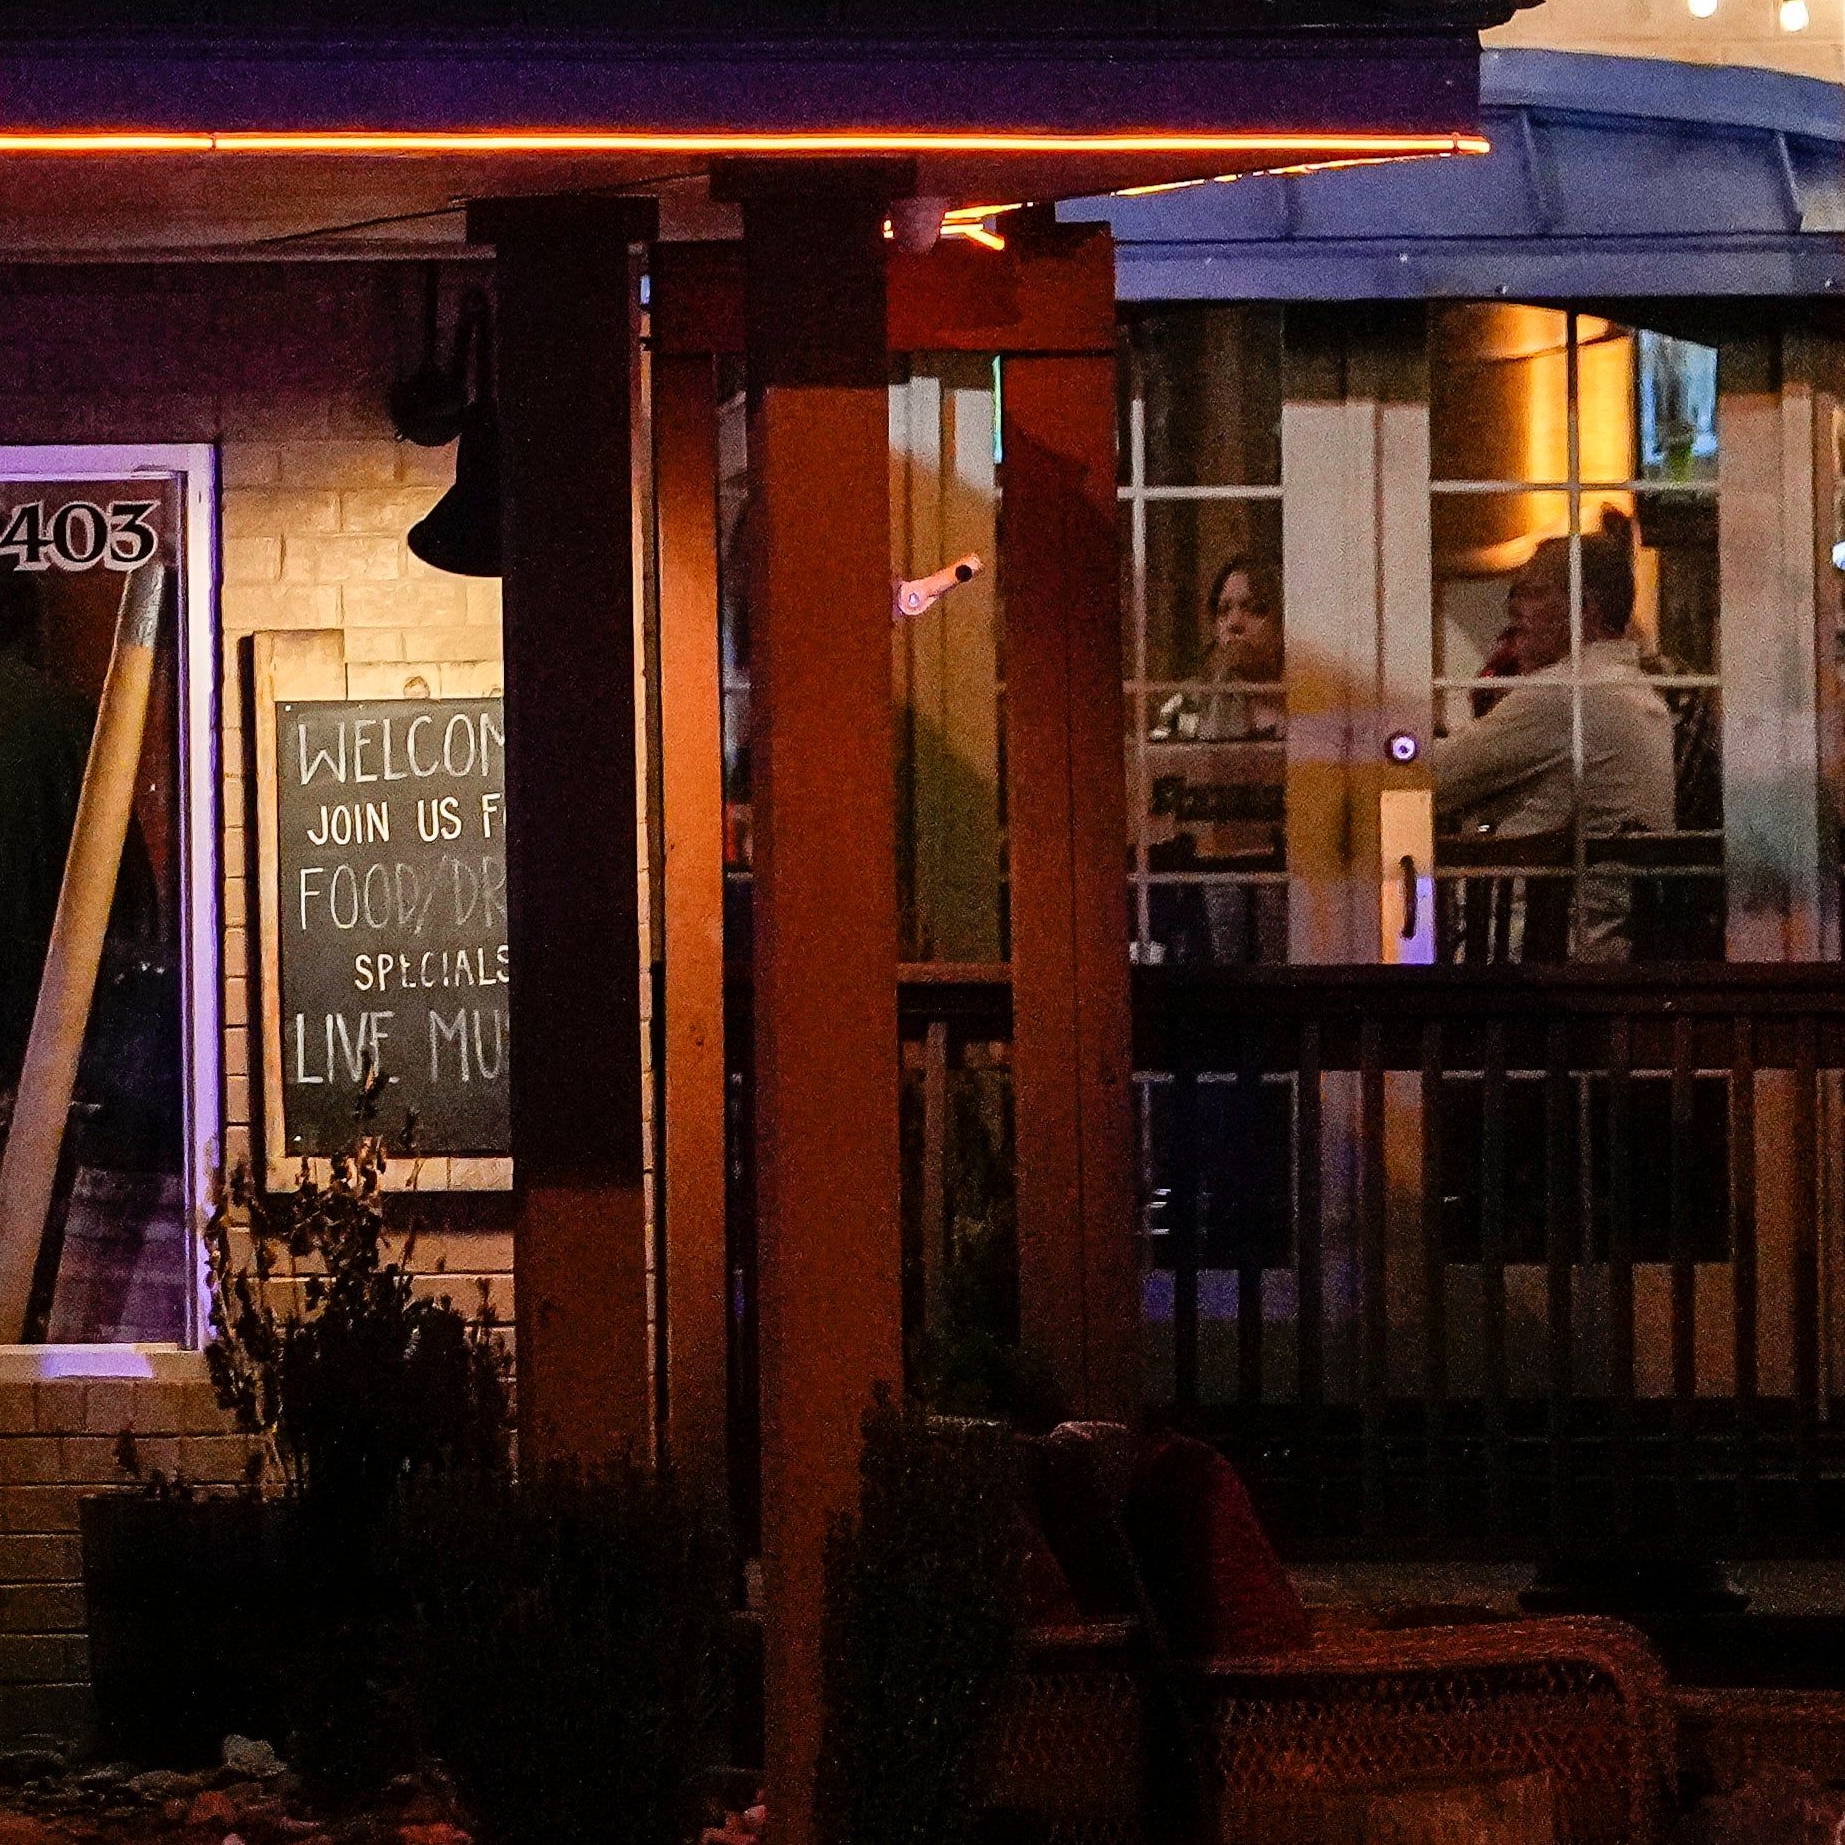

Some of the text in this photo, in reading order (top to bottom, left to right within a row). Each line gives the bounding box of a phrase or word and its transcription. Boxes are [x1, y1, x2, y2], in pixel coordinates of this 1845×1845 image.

[307, 792, 507, 847] JOIN US F
[296, 1011, 399, 1085] LIVE
